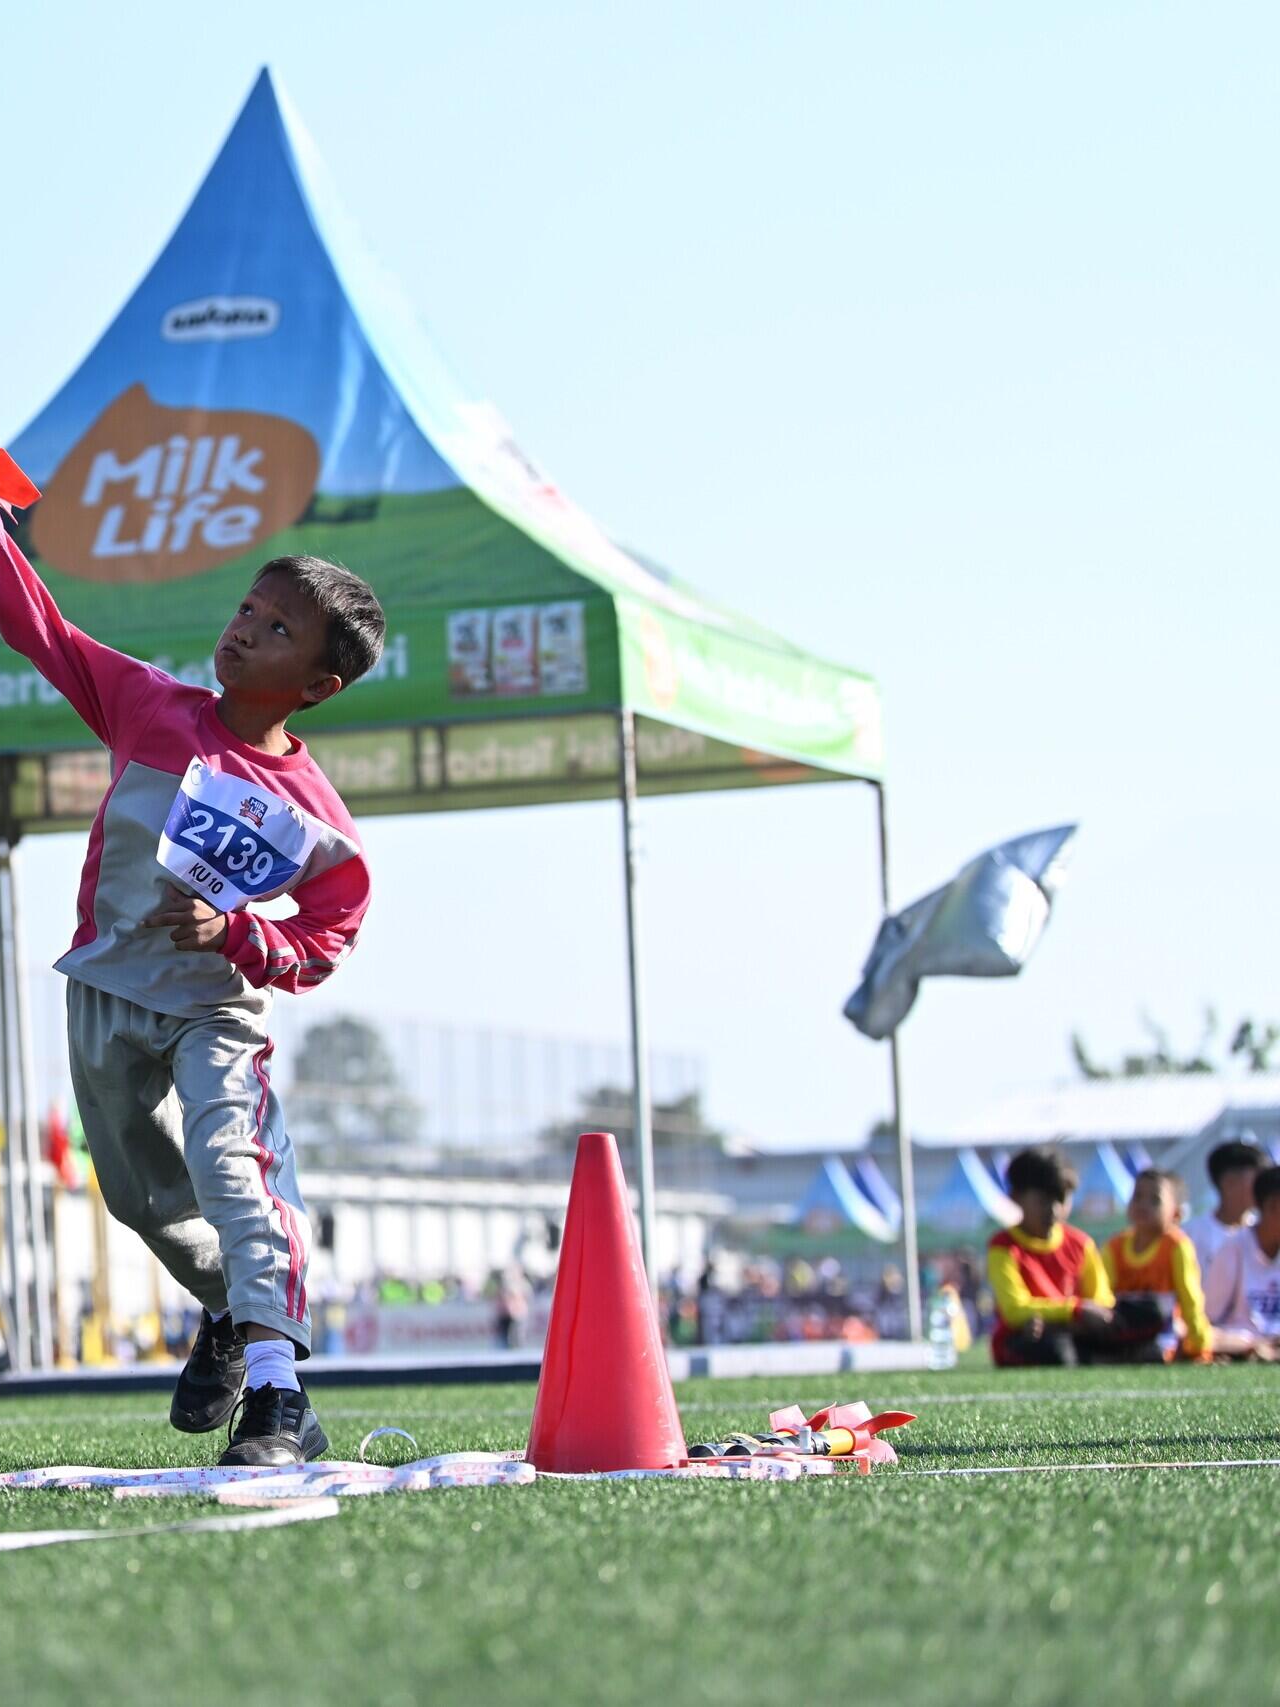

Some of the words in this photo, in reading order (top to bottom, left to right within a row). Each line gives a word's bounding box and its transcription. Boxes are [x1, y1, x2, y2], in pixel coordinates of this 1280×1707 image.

[81, 434, 266, 506] Milk
[91, 492, 261, 557] Life
[249, 806, 263, 819] Life
[250, 798, 266, 813] Milk
[180, 810, 274, 886] 2139
[189, 862, 210, 883] KU
[208, 877, 224, 895] 10
